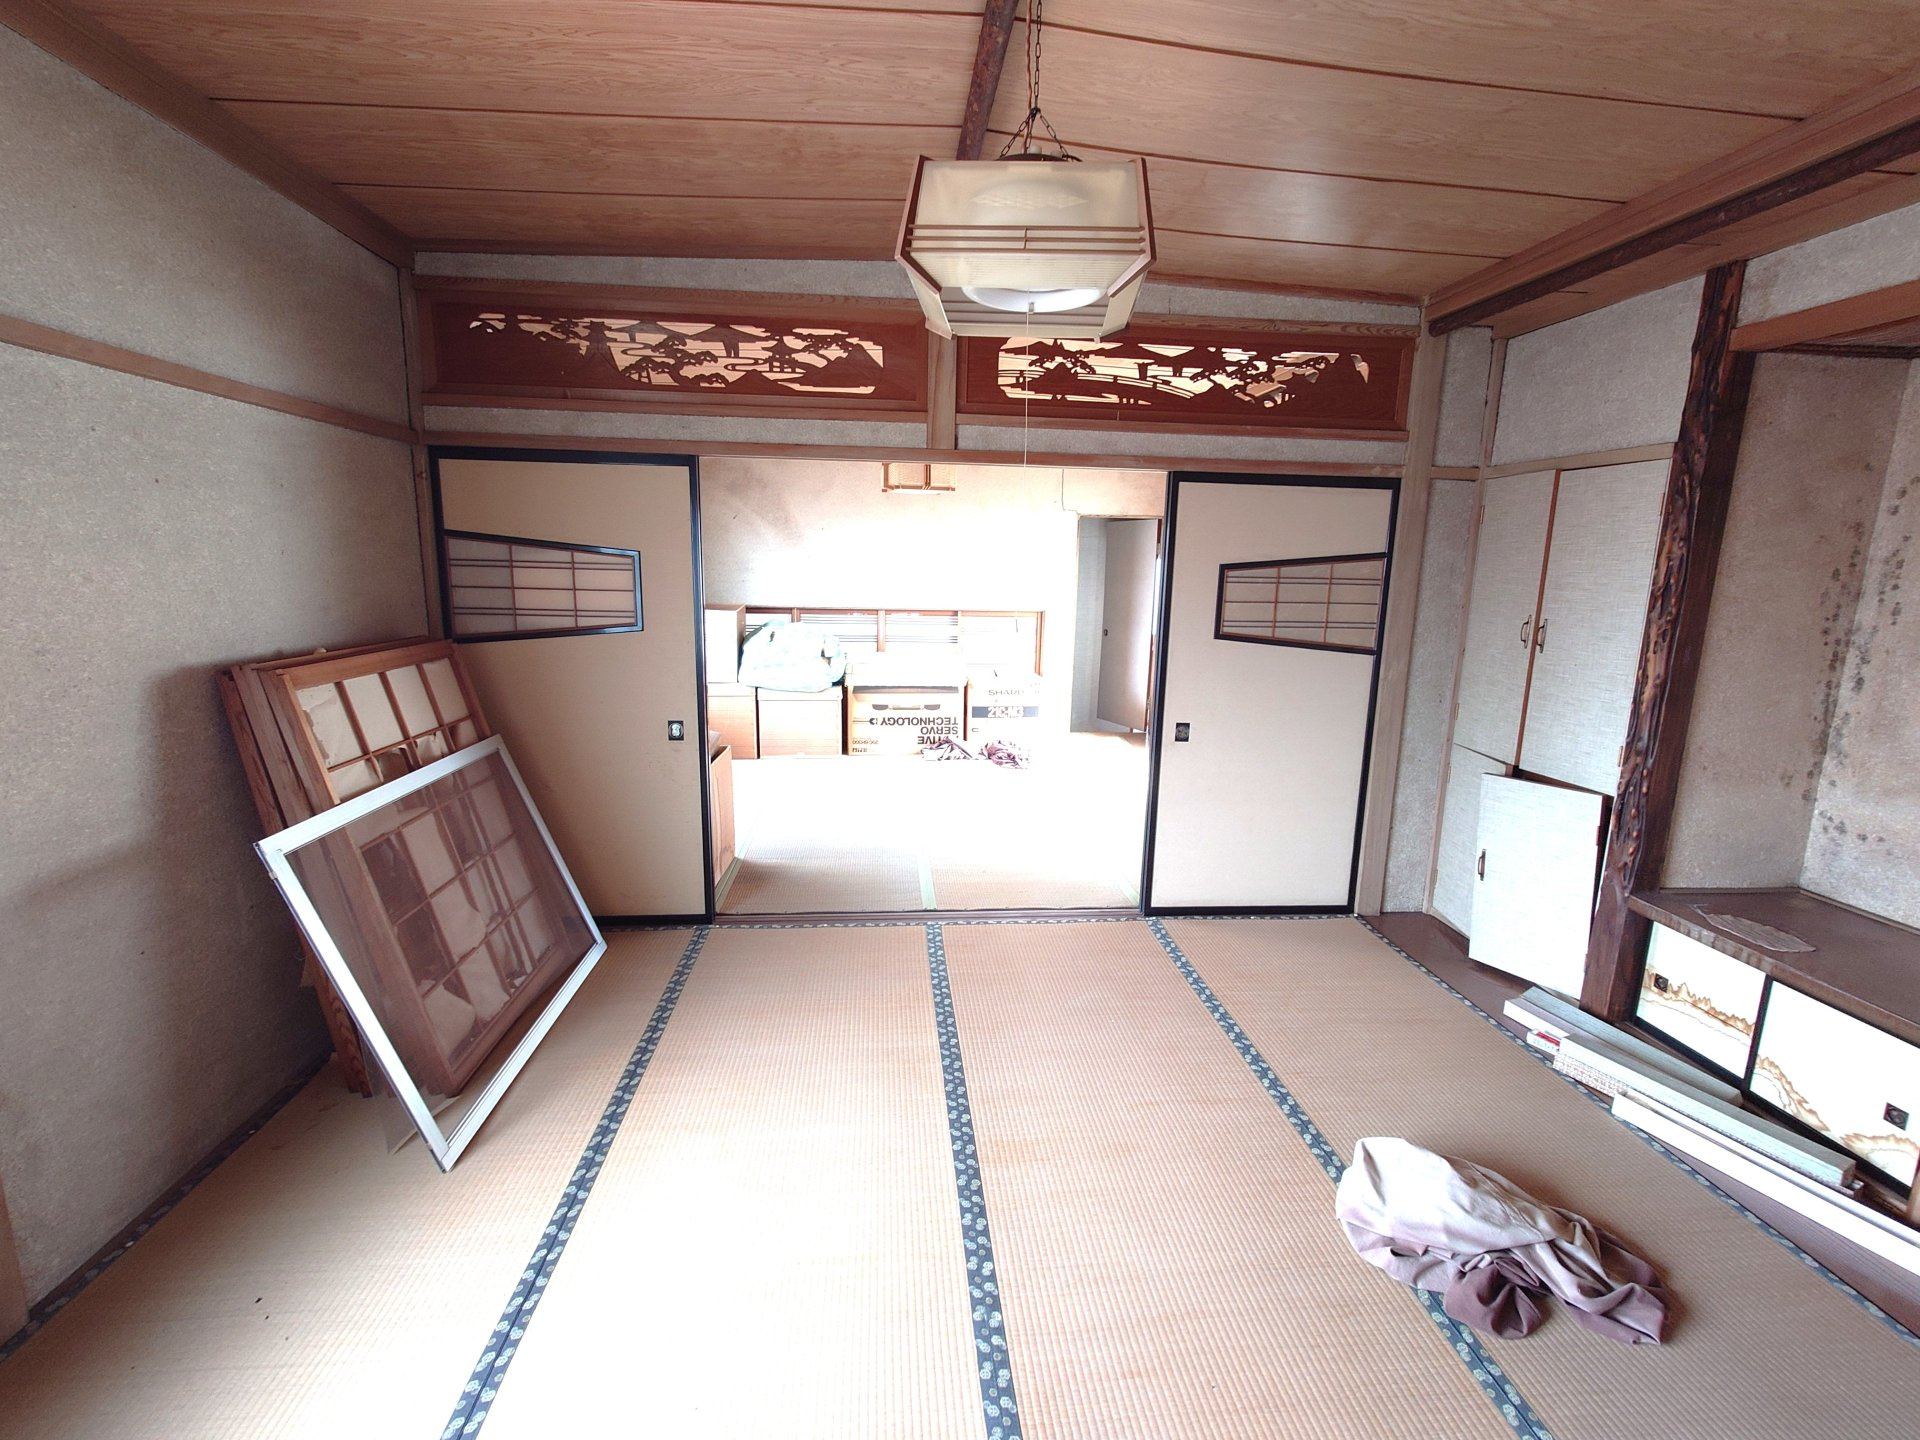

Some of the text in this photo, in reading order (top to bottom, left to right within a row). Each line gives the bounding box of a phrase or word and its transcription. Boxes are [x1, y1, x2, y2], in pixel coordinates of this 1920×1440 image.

[880, 717, 959, 726] TECHNOLOGY
[920, 726, 959, 735] SERVO
[917, 736, 959, 745] TIVE
